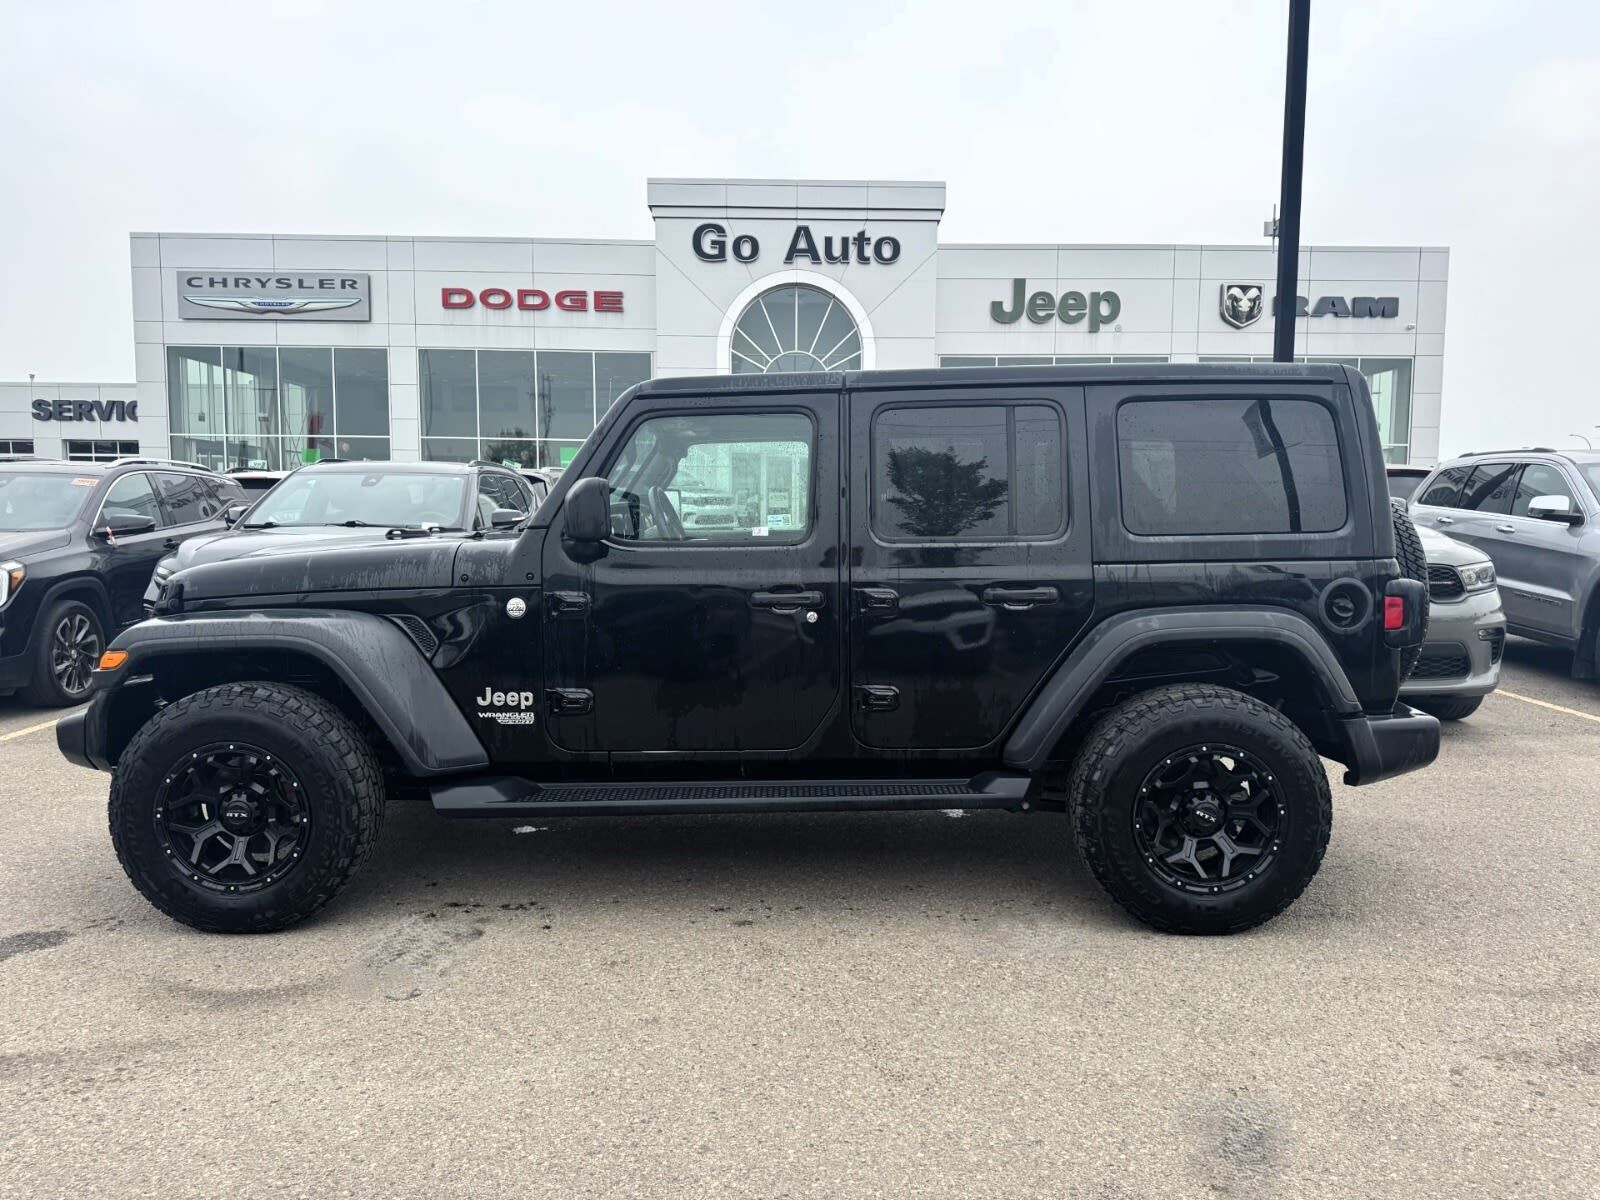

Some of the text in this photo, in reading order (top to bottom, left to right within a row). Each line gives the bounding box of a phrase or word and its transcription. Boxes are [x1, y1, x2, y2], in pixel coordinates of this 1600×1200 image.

[692, 222, 901, 265] Go Auto
[186, 276, 359, 290] CHRYSLER
[441, 287, 624, 313] DODGE
[990, 277, 1122, 334] Jeep
[476, 687, 534, 710] Jeep
